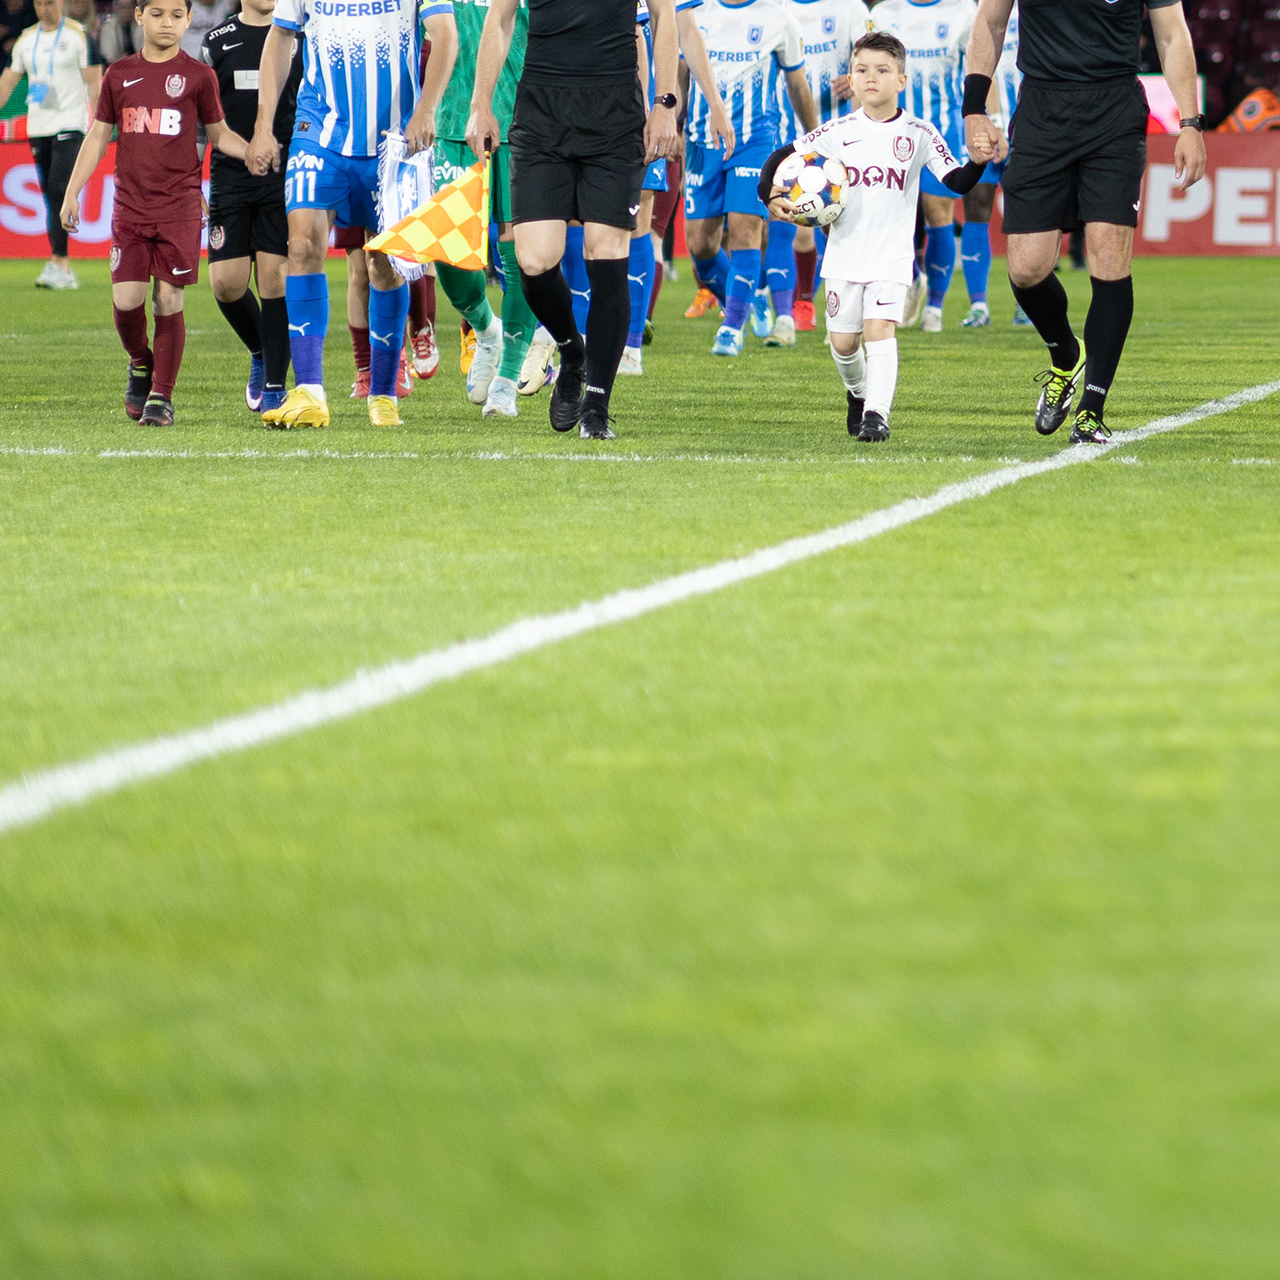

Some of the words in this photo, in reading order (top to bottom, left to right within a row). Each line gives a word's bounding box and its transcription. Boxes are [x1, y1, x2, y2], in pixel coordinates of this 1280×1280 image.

[208, 23, 236, 40] .msg
[122, 107, 182, 136] BNB
[808, 125, 830, 143] DSC
[934, 143, 955, 166] DSC
[294, 171, 317, 203] 11
[845, 166, 907, 191] DON
